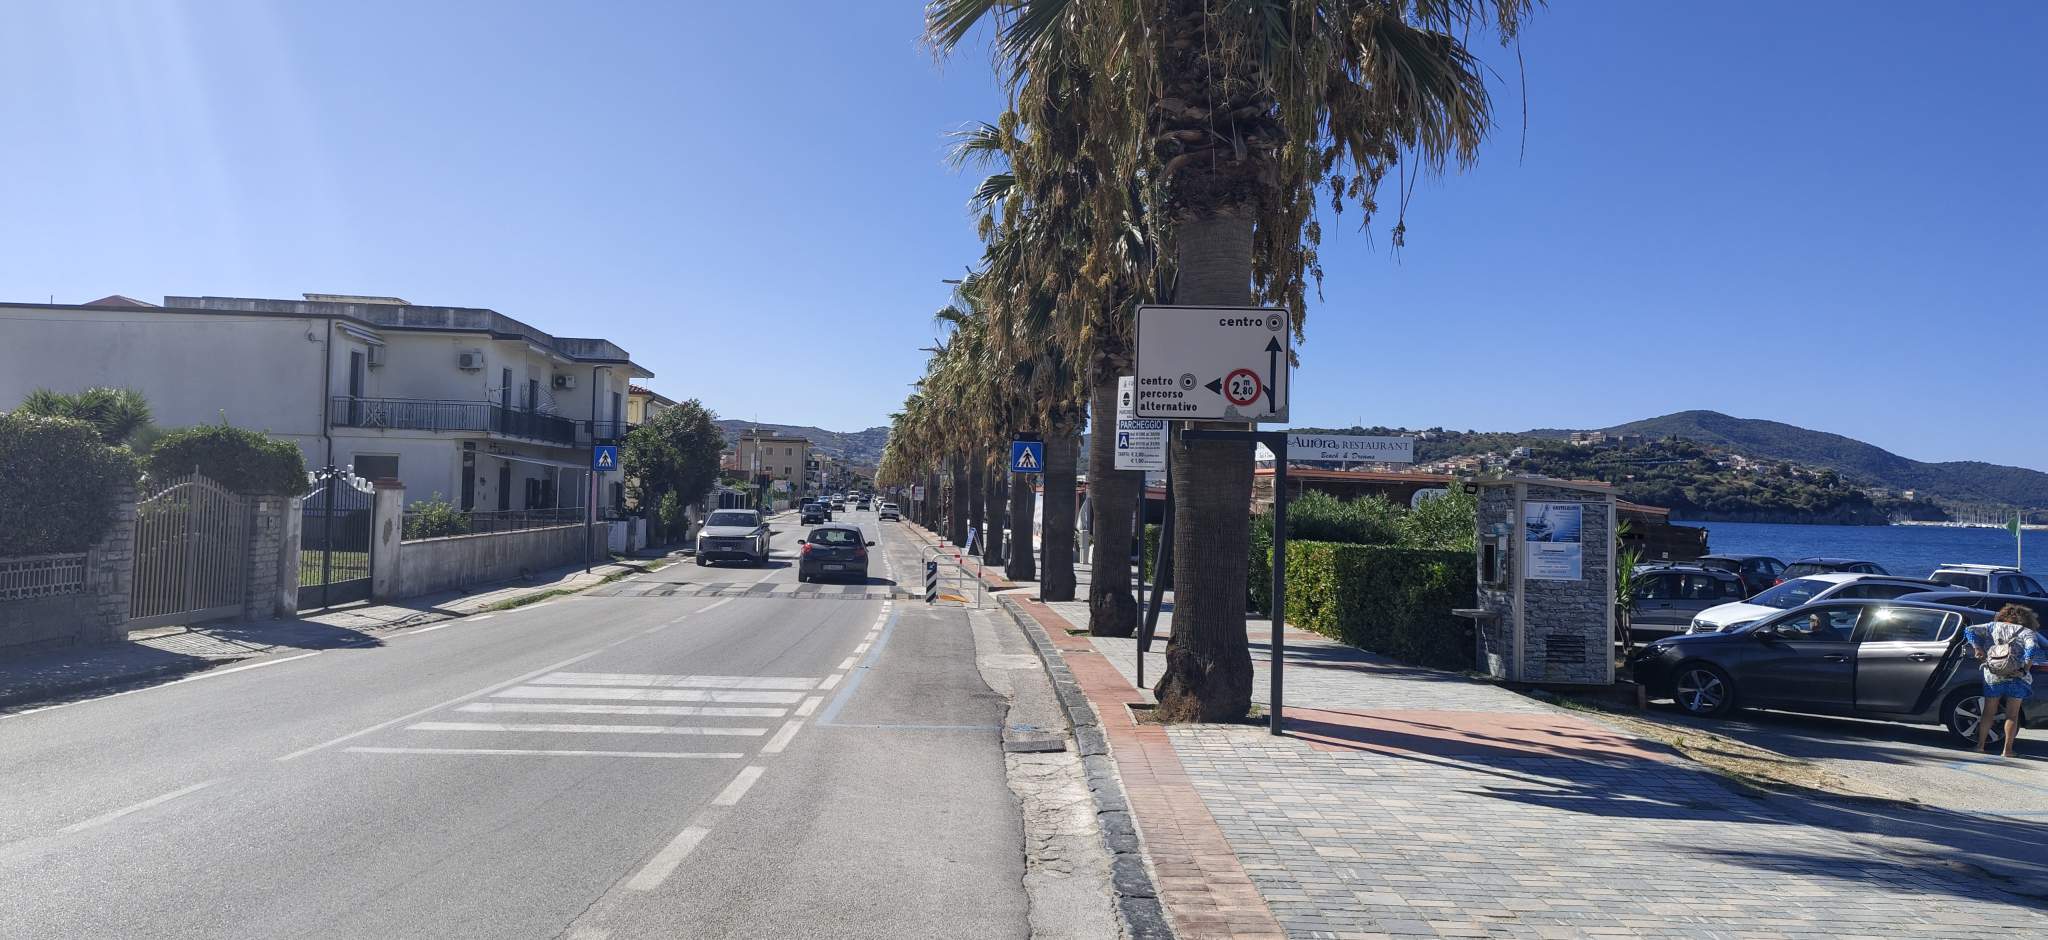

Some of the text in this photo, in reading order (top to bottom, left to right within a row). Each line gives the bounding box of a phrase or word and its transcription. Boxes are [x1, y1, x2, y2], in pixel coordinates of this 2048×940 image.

[1219, 316, 1263, 327] centro
[1140, 376, 1173, 386] centro
[1140, 390, 1184, 400] percorso
[1140, 401, 1198, 412] alternativo
[1120, 420, 1162, 429] PARCHEGGIO
[1119, 435, 1128, 447] A
[1342, 440, 1409, 451] RESTAURANT
